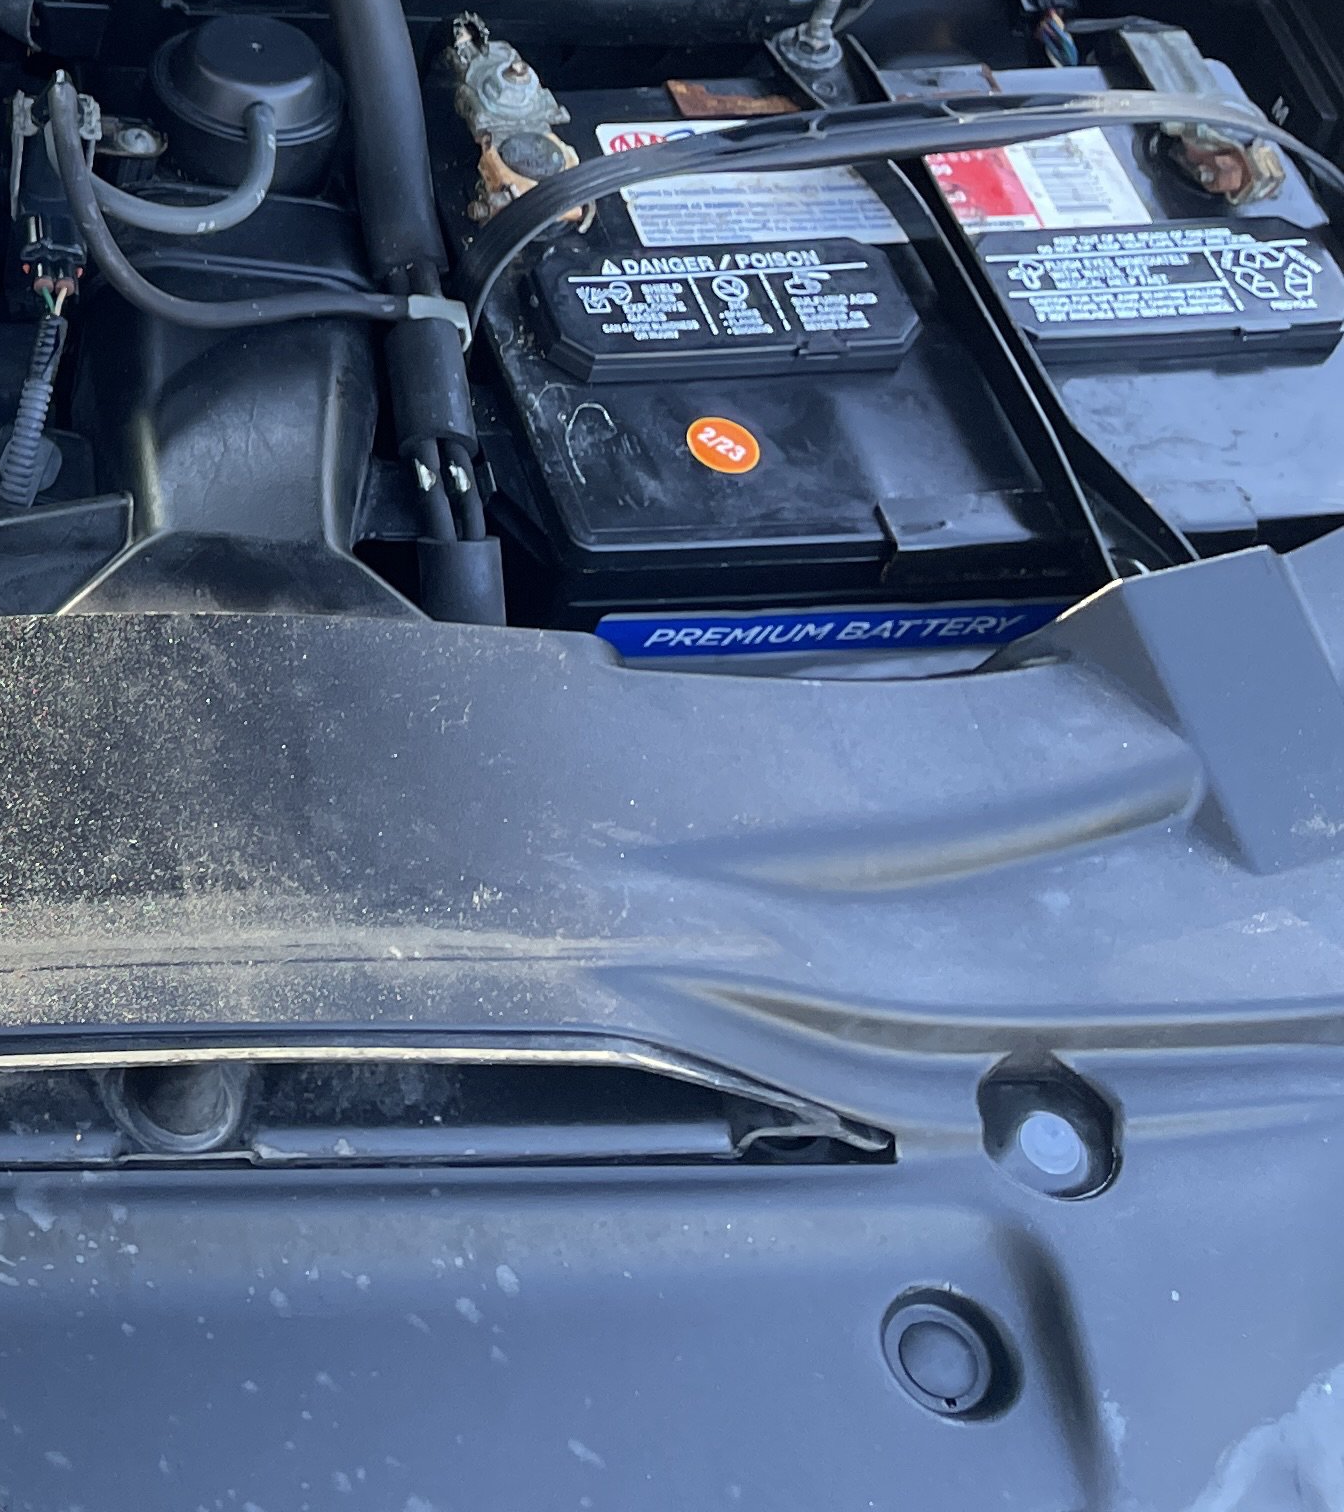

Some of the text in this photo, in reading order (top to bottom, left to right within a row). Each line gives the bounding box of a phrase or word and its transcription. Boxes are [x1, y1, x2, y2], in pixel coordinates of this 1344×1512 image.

[622, 255, 716, 275] DANGER
[734, 250, 820, 269] POISON
[697, 426, 747, 462] 2/23
[643, 615, 1027, 648] PREMIUM BATTERY
